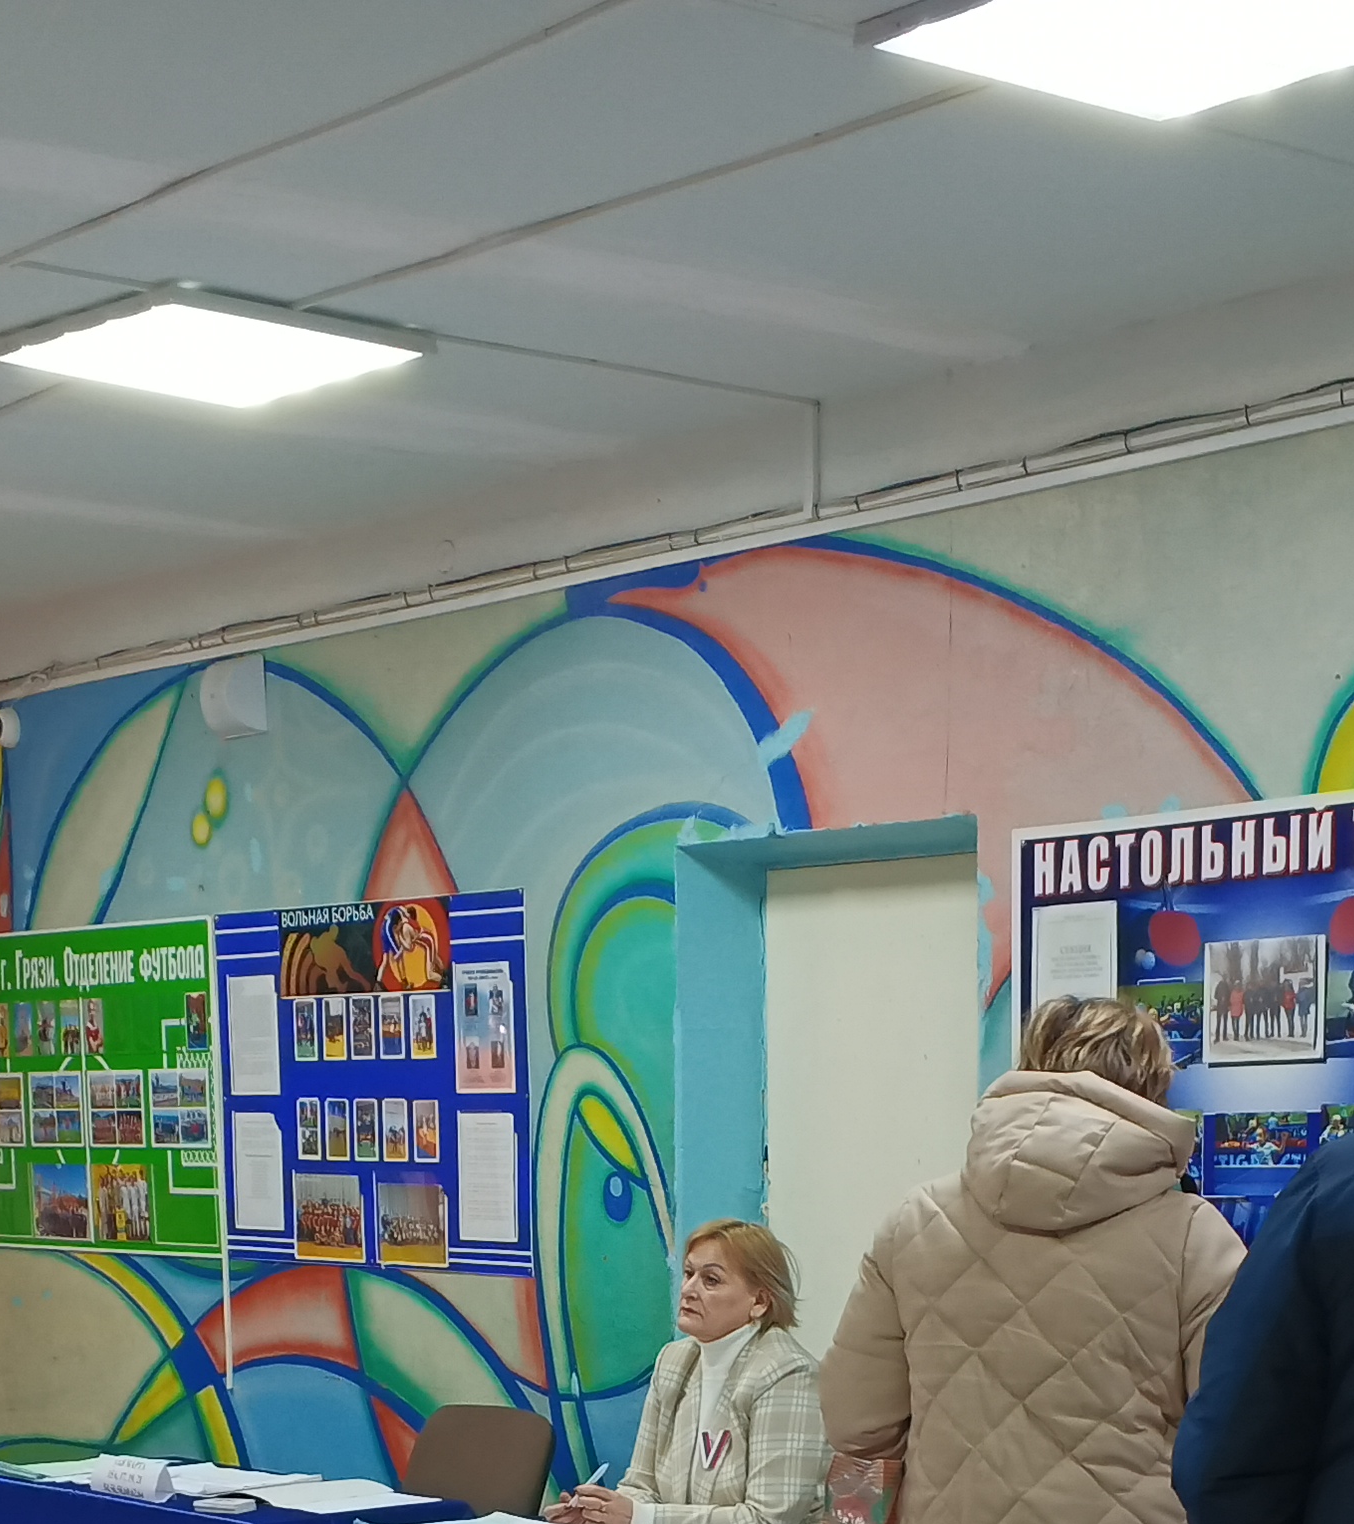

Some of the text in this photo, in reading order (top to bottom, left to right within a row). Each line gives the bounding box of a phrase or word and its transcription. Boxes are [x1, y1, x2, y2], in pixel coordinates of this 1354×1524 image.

[1031, 808, 1335, 898] НАСТОЛЬНЫЙ
[281, 908, 330, 928] ВОЛЬНАЯ
[63, 946, 135, 993] ОТДЕЛЕНИЕ
[139, 943, 206, 982] ФУТБОЛА
